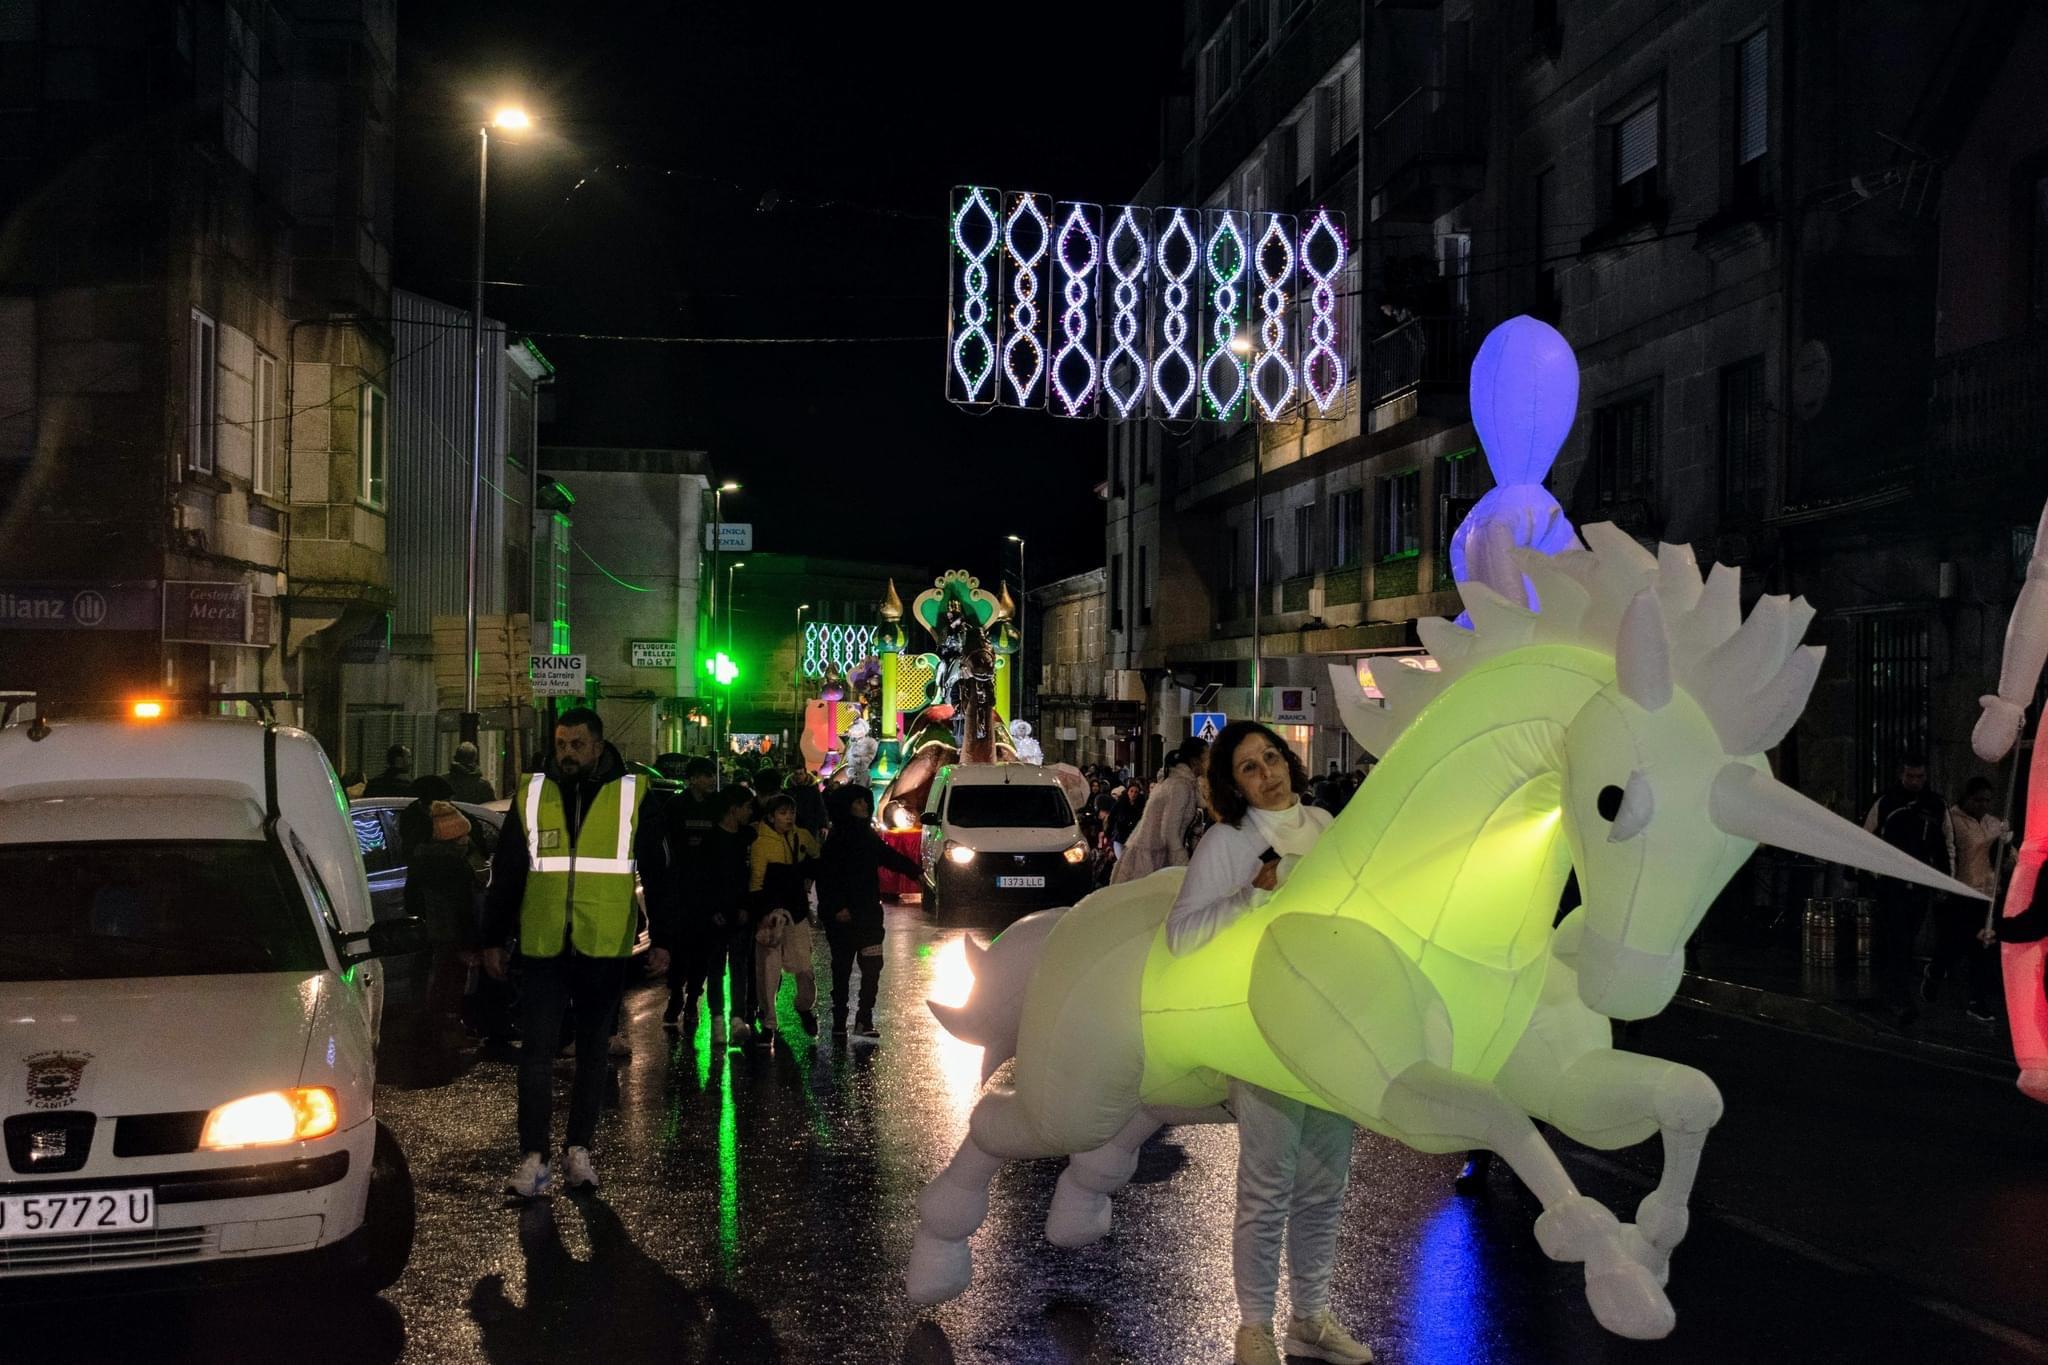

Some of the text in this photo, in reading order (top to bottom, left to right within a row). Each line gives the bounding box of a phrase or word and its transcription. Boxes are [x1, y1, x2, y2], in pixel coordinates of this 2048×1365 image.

[189, 603, 236, 618] Mera
[1002, 878, 1044, 886] 1373 LLC
[23, 1195, 117, 1230] 5772
[129, 1193, 148, 1223] U
